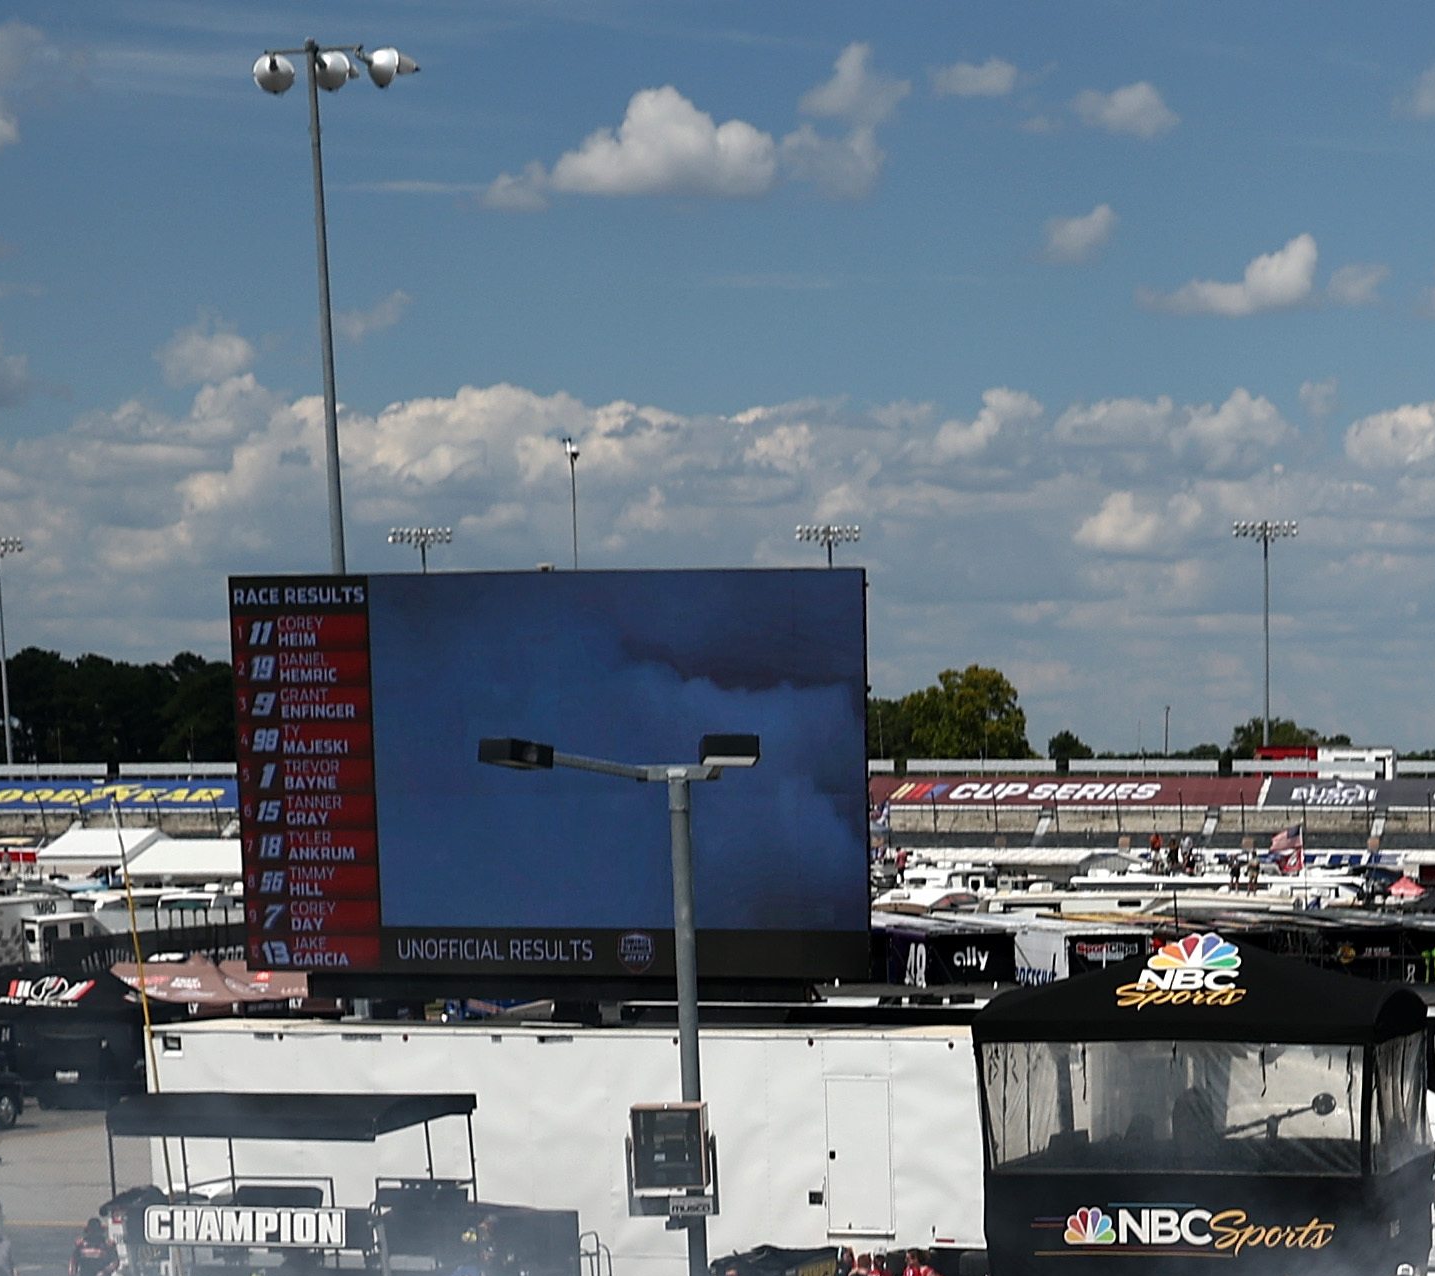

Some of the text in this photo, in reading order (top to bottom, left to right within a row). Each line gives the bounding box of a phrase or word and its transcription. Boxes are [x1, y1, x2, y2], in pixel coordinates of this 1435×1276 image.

[233, 586, 364, 605] RACE RESULTS
[249, 620, 274, 645] 11
[277, 615, 324, 631] COREY
[278, 632, 316, 647] HEIM
[250, 655, 275, 681] 19
[279, 651, 329, 667] DANIEL
[279, 668, 337, 683] HEMRIC
[251, 692, 275, 716] 9
[280, 687, 328, 702] GRANT
[281, 703, 355, 718] ENFINGER
[252, 728, 280, 752] 98
[283, 724, 300, 738] TY
[283, 740, 349, 754] MAJESKI
[259, 763, 277, 788] 1
[284, 759, 340, 773] TREVOR
[284, 776, 336, 790] BAYNE
[948, 782, 1163, 801] CUP SERIES
[256, 800, 281, 823] 15
[285, 795, 342, 809] TANNER
[286, 811, 328, 826] GRAY
[260, 835, 284, 859] 18
[287, 831, 332, 845] TYLER
[288, 846, 355, 861] ANKRUM
[289, 866, 336, 880] TIMMY
[289, 882, 323, 897] HILL
[263, 904, 286, 929] 7
[289, 901, 336, 915] COREY
[290, 917, 323, 931] DAY
[262, 941, 290, 965] 13
[292, 936, 327, 950] JAKE
[292, 952, 350, 967] GARCIA
[397, 938, 505, 962] UNOFFICIAL
[509, 939, 594, 962] RESULTS
[953, 946, 989, 971] ally
[1136, 969, 1240, 991] NBC
[1116, 982, 1247, 1010] Sports
[671, 1204, 711, 1213] musco
[148, 1209, 341, 1245] CHAMPION
[1119, 1208, 1336, 1257] NBC Sports
